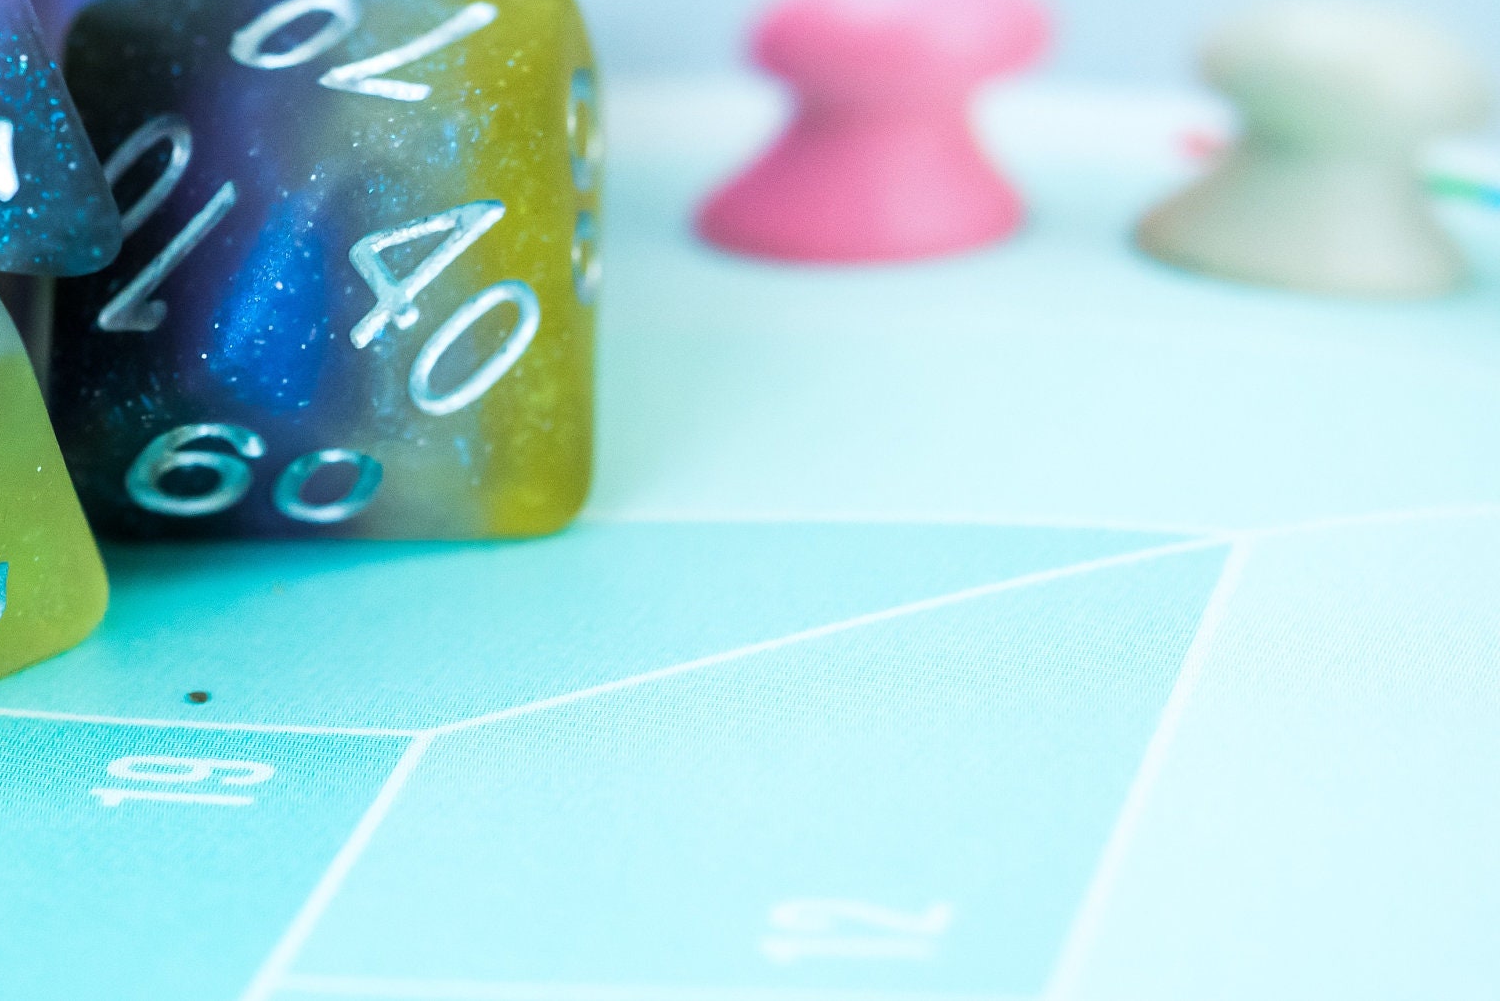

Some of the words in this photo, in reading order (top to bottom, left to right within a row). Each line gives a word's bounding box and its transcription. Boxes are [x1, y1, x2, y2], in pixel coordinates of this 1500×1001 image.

[349, 200, 541, 417] 40
[126, 422, 384, 525] 60
[88, 754, 276, 808] 19
[758, 895, 956, 967] 12
